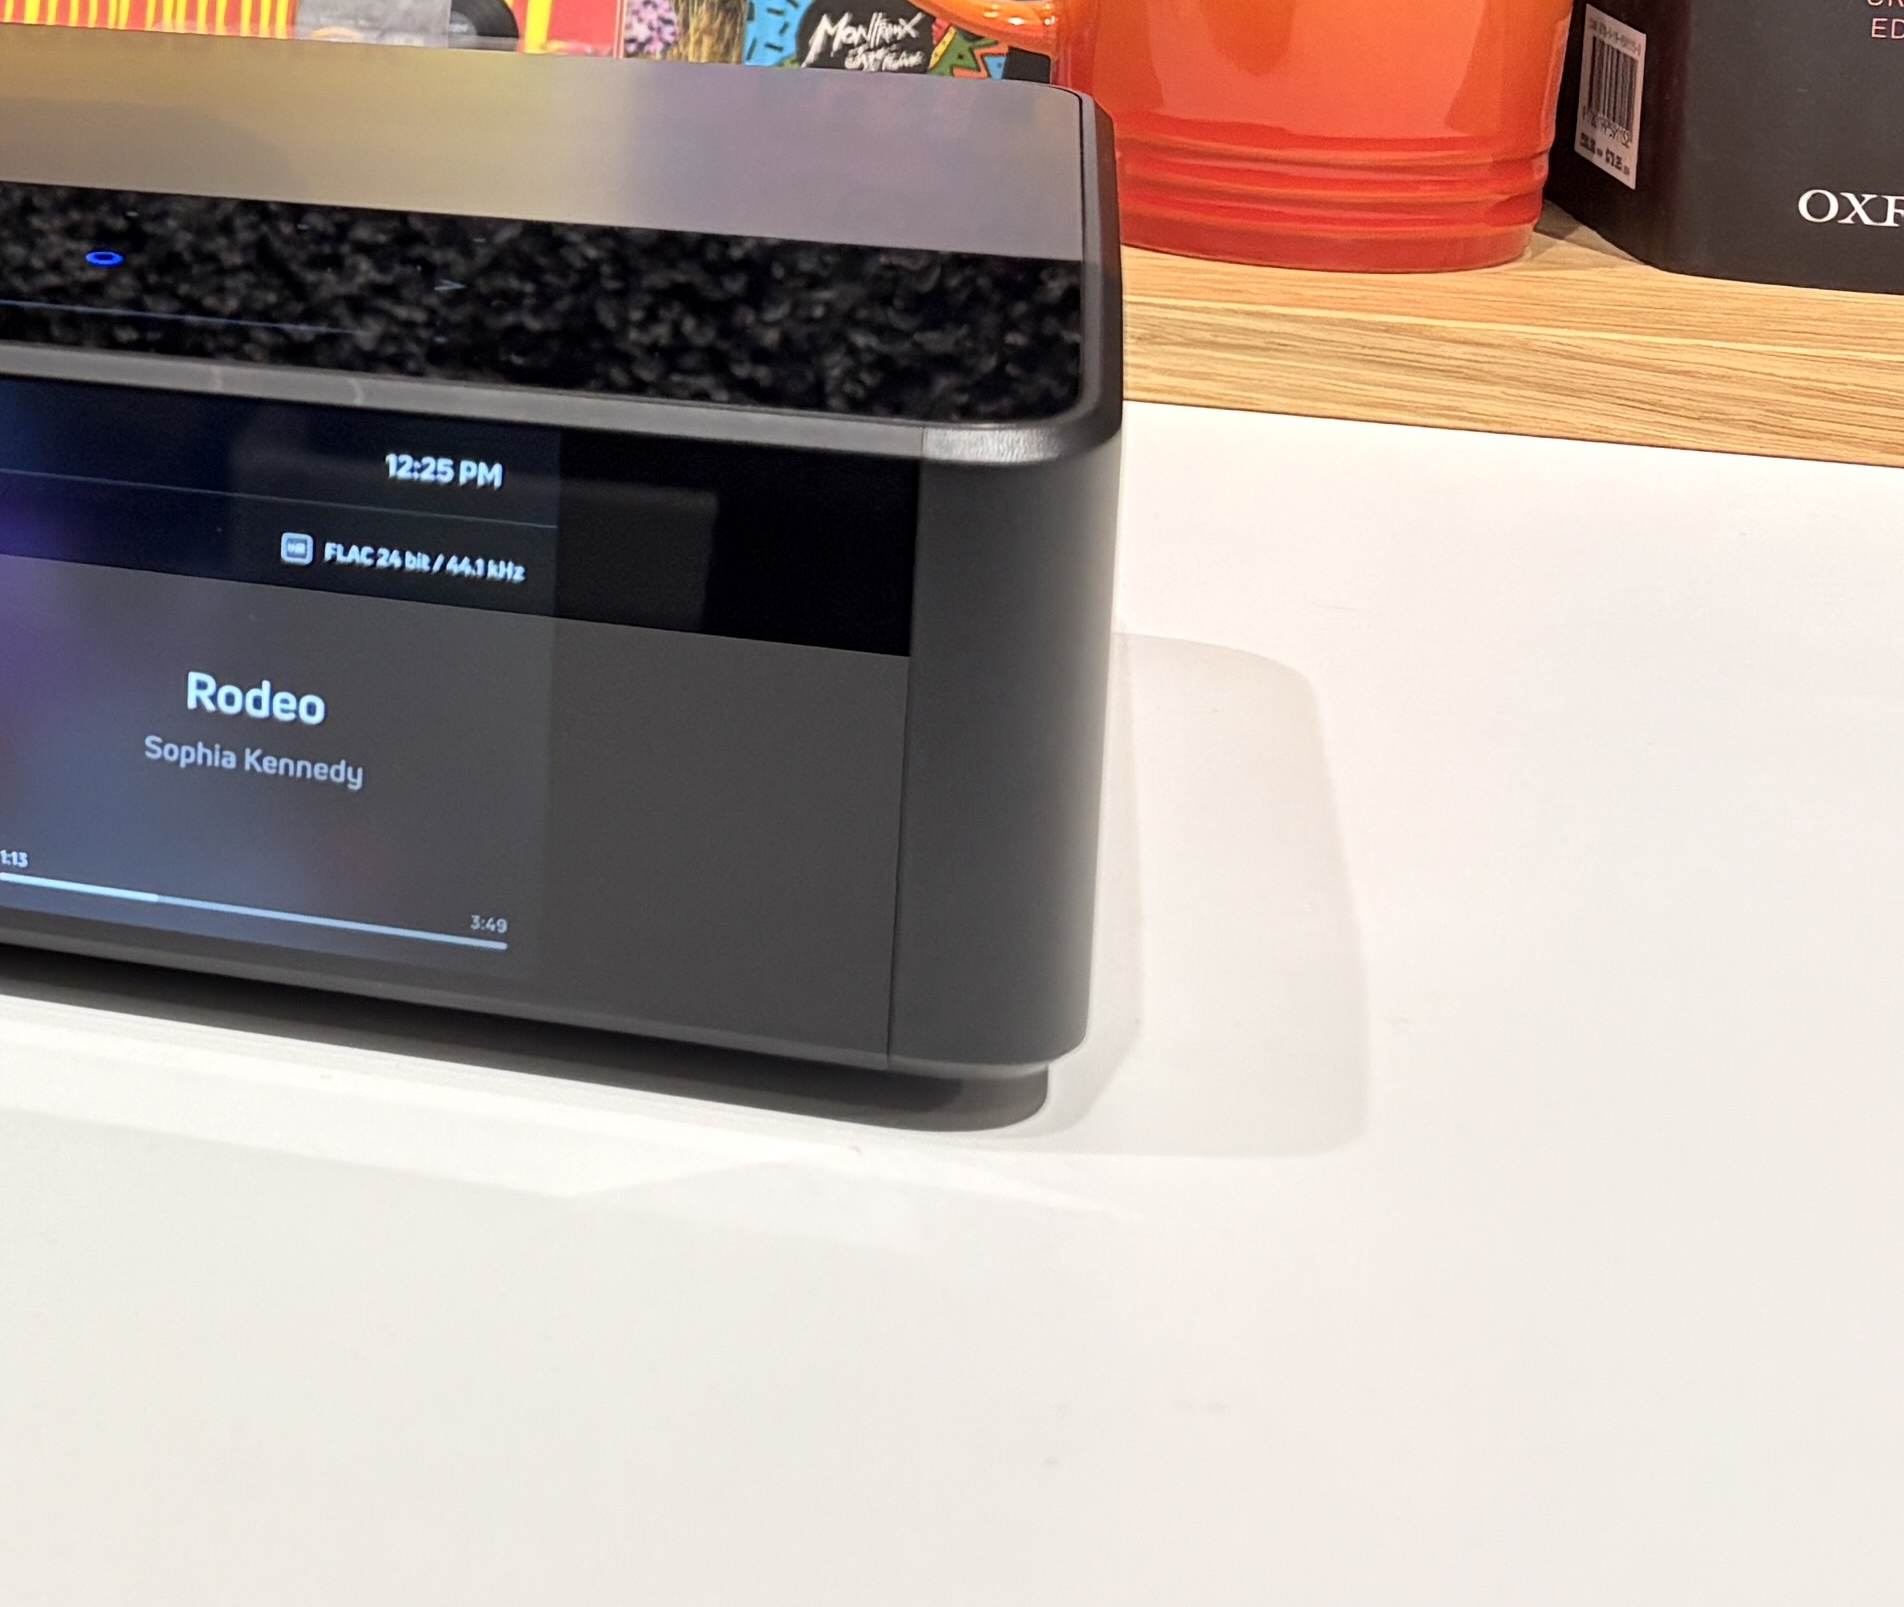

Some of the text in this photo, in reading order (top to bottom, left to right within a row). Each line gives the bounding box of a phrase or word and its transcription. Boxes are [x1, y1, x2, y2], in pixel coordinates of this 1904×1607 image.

[385, 453, 504, 491] 12:25 PM
[324, 542, 374, 567] FLAC
[375, 547, 402, 569] 24
[404, 550, 431, 572] bit
[432, 553, 445, 575] /
[446, 554, 485, 578] 44.1
[486, 559, 526, 584] kHz
[187, 670, 326, 726] Rodeo
[144, 735, 364, 792] Sophia Kennedy
[0, 849, 29, 868] 1:13
[470, 914, 508, 934] 3:49
